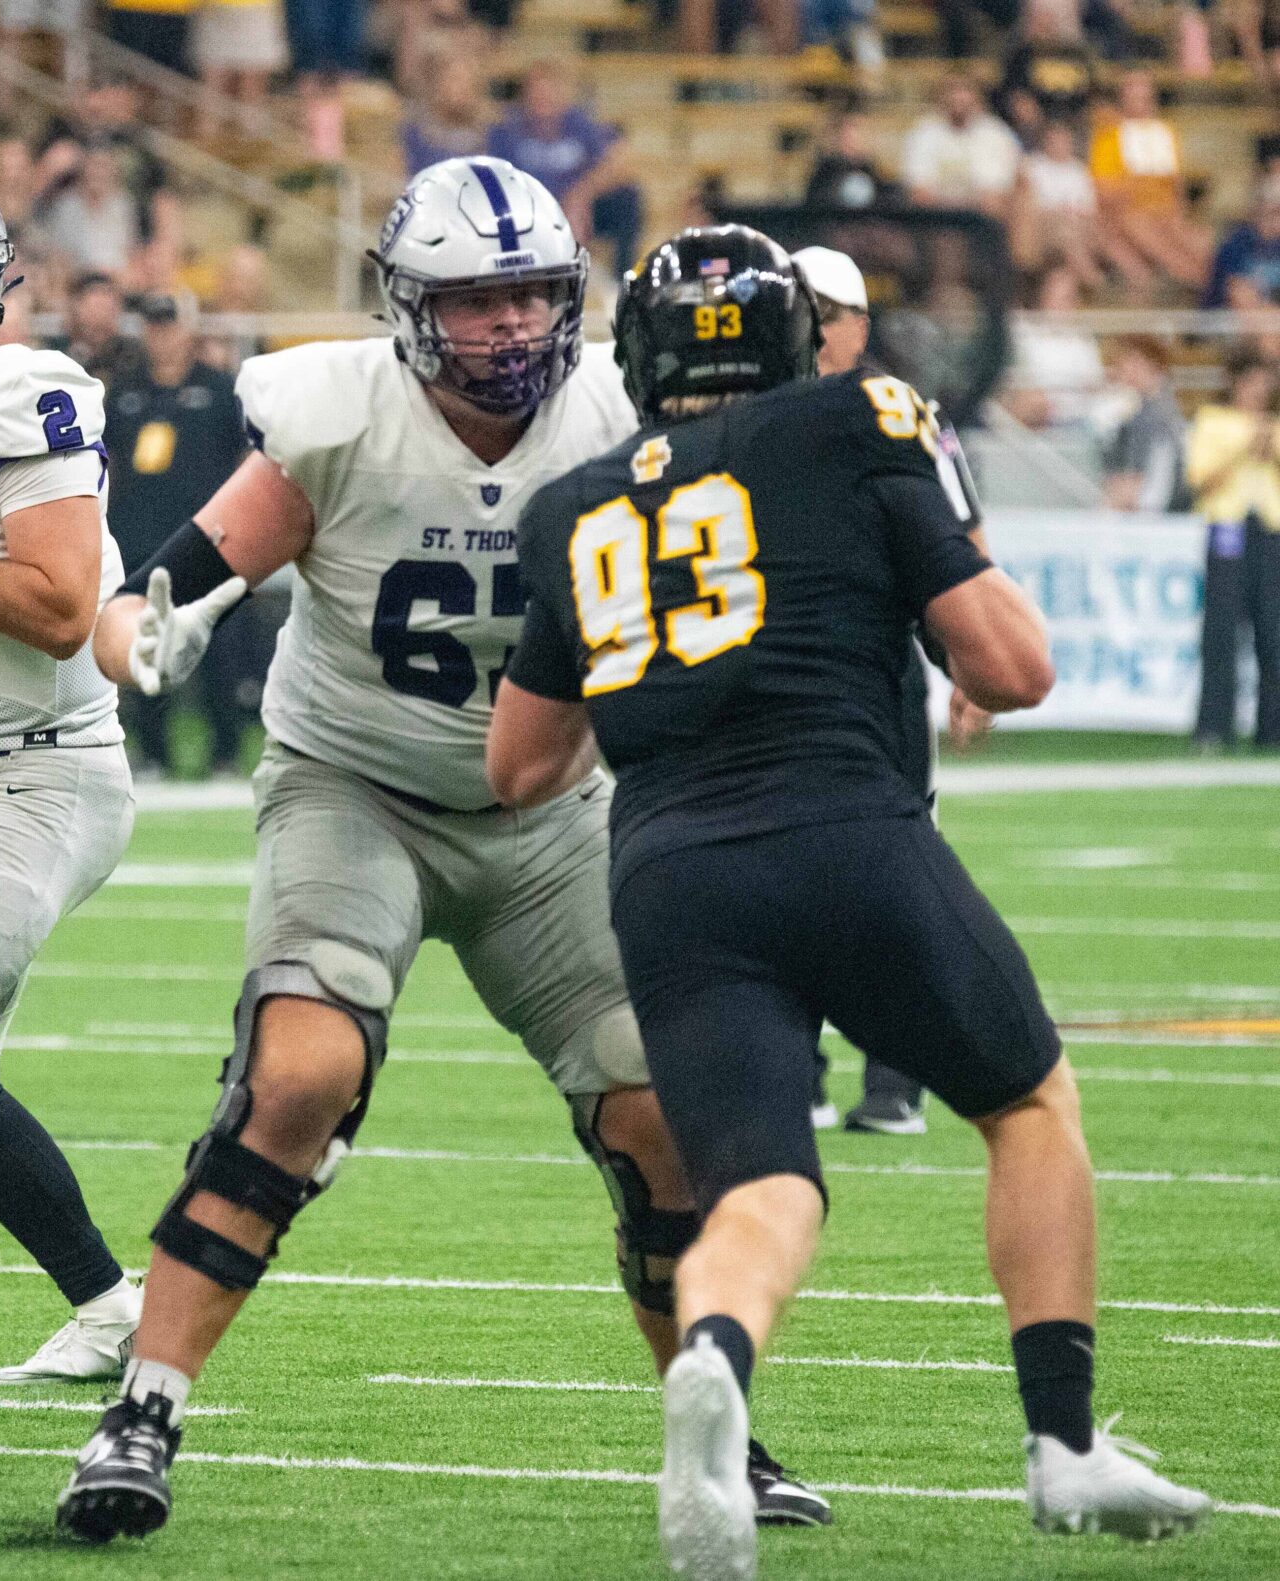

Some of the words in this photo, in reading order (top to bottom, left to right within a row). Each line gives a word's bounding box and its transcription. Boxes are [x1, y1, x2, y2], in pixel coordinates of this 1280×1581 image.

[694, 303, 743, 339] 93
[36, 389, 85, 452] 2
[422, 527, 454, 550] ST.
[568, 471, 767, 698] 93
